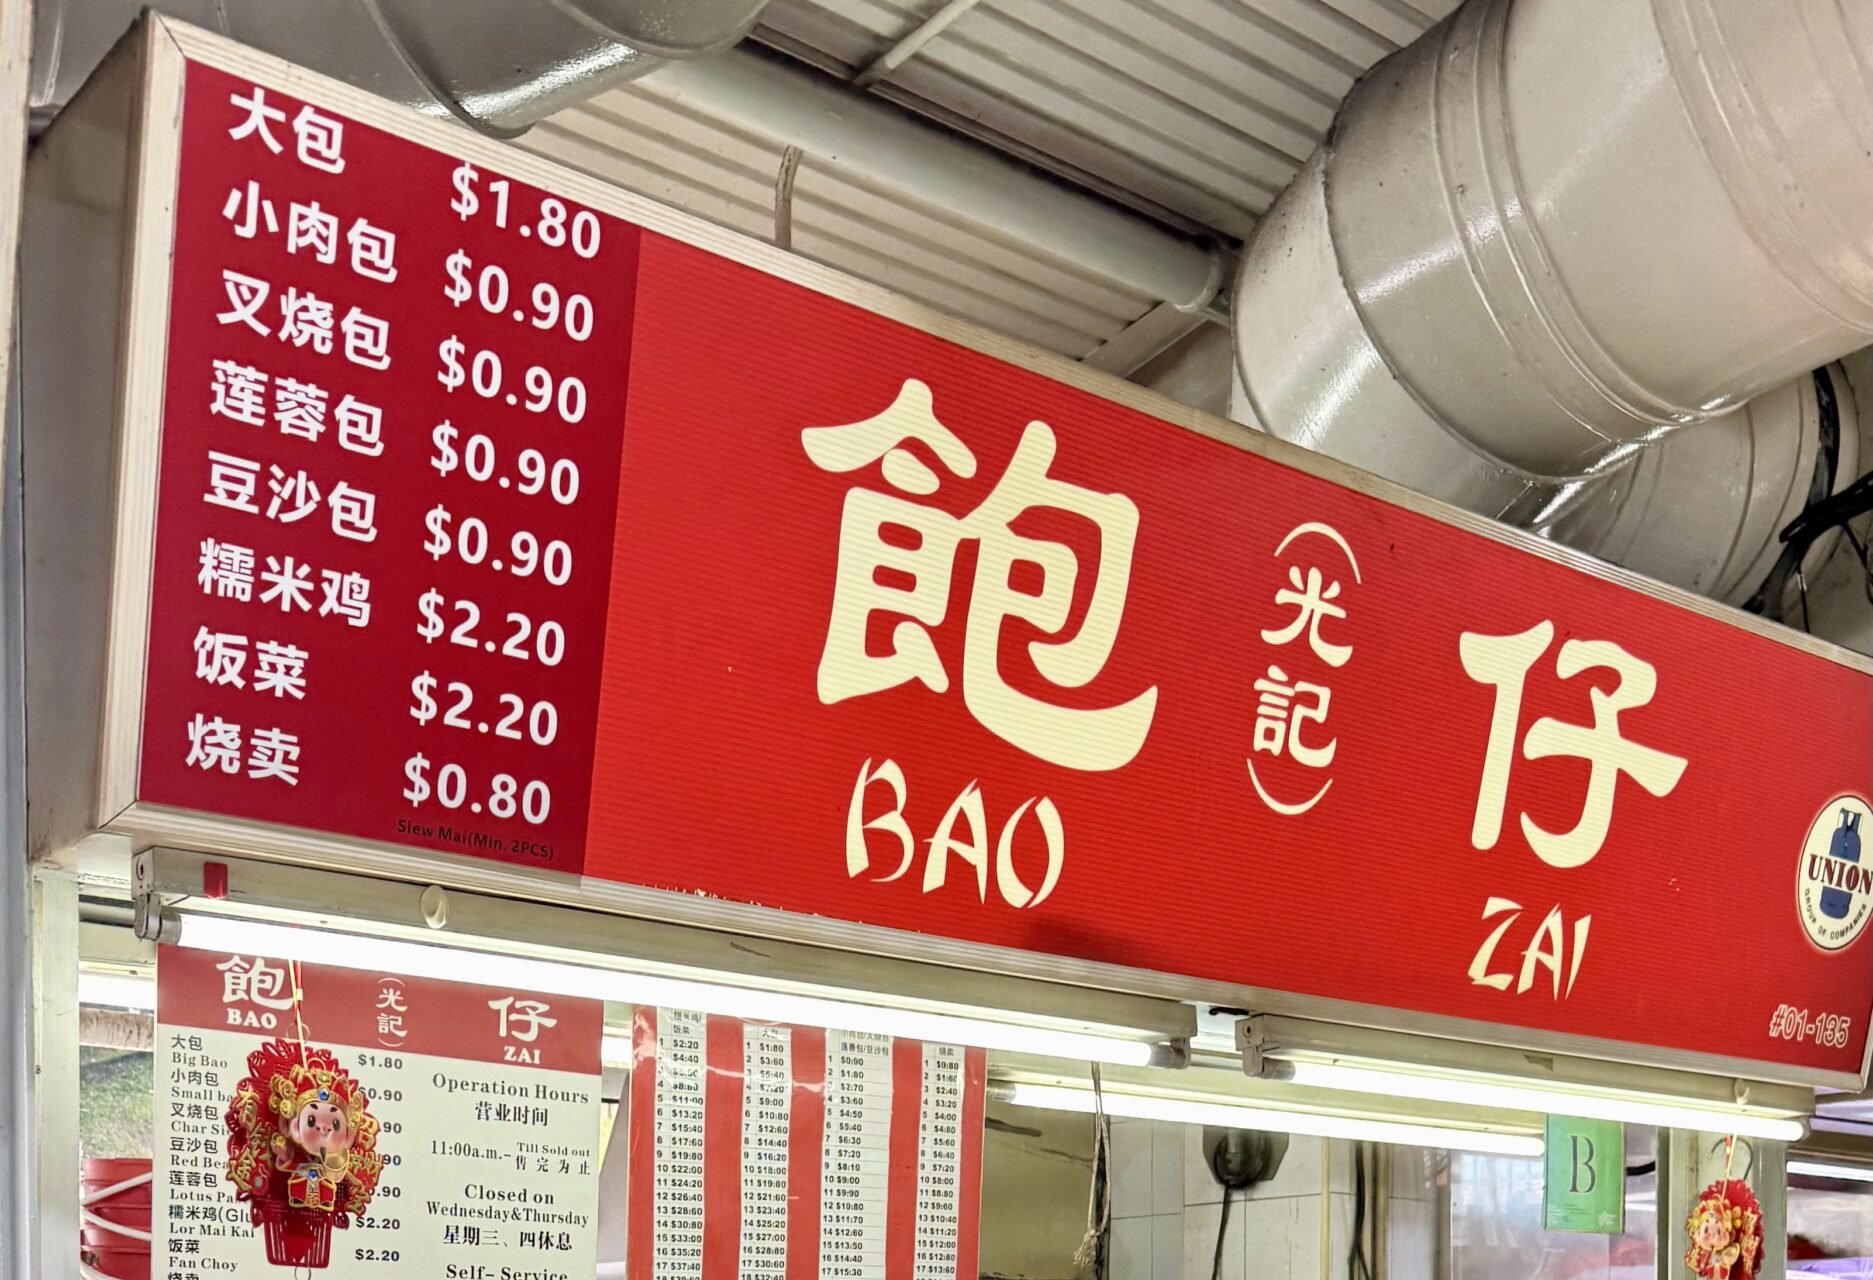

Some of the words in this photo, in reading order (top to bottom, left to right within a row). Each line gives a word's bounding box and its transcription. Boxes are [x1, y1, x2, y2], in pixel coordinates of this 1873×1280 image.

[229, 86, 345, 175] 大包
[451, 163, 601, 259] $1.80
[222, 181, 398, 283] 小肉包
[445, 250, 594, 341] $0.90
[217, 269, 392, 371] 叉烧包
[438, 335, 587, 424] $0.90
[209, 360, 385, 456] 莲蓉包
[431, 421, 580, 506] $0.90
[203, 451, 378, 542] 豆沙包
[423, 504, 573, 586] $0.90
[198, 537, 371, 628] 糯米鸡
[417, 588, 565, 667] $2.20
[801, 377, 1158, 772] 飽
[1459, 619, 1689, 869] 仔
[194, 625, 308, 700] 饭菜
[409, 670, 558, 746] $2.20
[186, 713, 300, 787] 烧卖
[403, 752, 551, 825] $0.80
[845, 757, 1065, 909] BAO
[1467, 896, 1592, 1001] ZAI
[1808, 854, 1873, 895] UNION
[215, 955, 294, 1010] 飽
[488, 996, 557, 1042] 仔
[226, 1008, 277, 1029] BAO
[504, 1046, 541, 1064] ZAI
[1769, 1004, 1850, 1048] #01-135
[171, 1034, 202, 1051] 大包
[172, 1052, 195, 1067] Big
[201, 1056, 227, 1068] Bao
[358, 1054, 403, 1069] $1.80
[171, 1068, 218, 1086] 小肉包
[432, 1073, 529, 1098] Operation
[535, 1084, 589, 1104] Hours
[171, 1086, 212, 1101] Small
[218, 1090, 233, 1102] ba
[171, 1103, 218, 1120] 叉烧包
[475, 1100, 548, 1126] 营业时间
[171, 1121, 206, 1135] Char
[170, 1137, 218, 1154] 豆沙包
[517, 1142, 538, 1154] Till
[541, 1144, 568, 1156] Sold
[571, 1148, 590, 1157] out
[170, 1154, 198, 1167] Red
[203, 1157, 228, 1169] Bea
[656, 1164, 668, 1173] 10
[744, 1165, 754, 1174] 10
[1569, 1134, 1596, 1194] B
[169, 1170, 217, 1188] 莲蓉包
[824, 1175, 834, 1183] 10
[170, 1188, 212, 1201] Lotus
[217, 1191, 236, 1203] Pa
[465, 1184, 527, 1203] Closed
[533, 1193, 554, 1205] on
[356, 1216, 400, 1230] $2.20
[427, 1201, 589, 1228] Wednesday&Thursday
[170, 1222, 195, 1235] Lor
[200, 1224, 225, 1236] Mai
[231, 1226, 254, 1238] Kai
[443, 1224, 572, 1250] 星期三、四休息
[168, 1238, 200, 1254] 饭菜
[355, 1248, 400, 1262] $2.20
[169, 1256, 196, 1268] Fan
[201, 1258, 238, 1272] Choy
[446, 1264, 494, 1280] Self-
